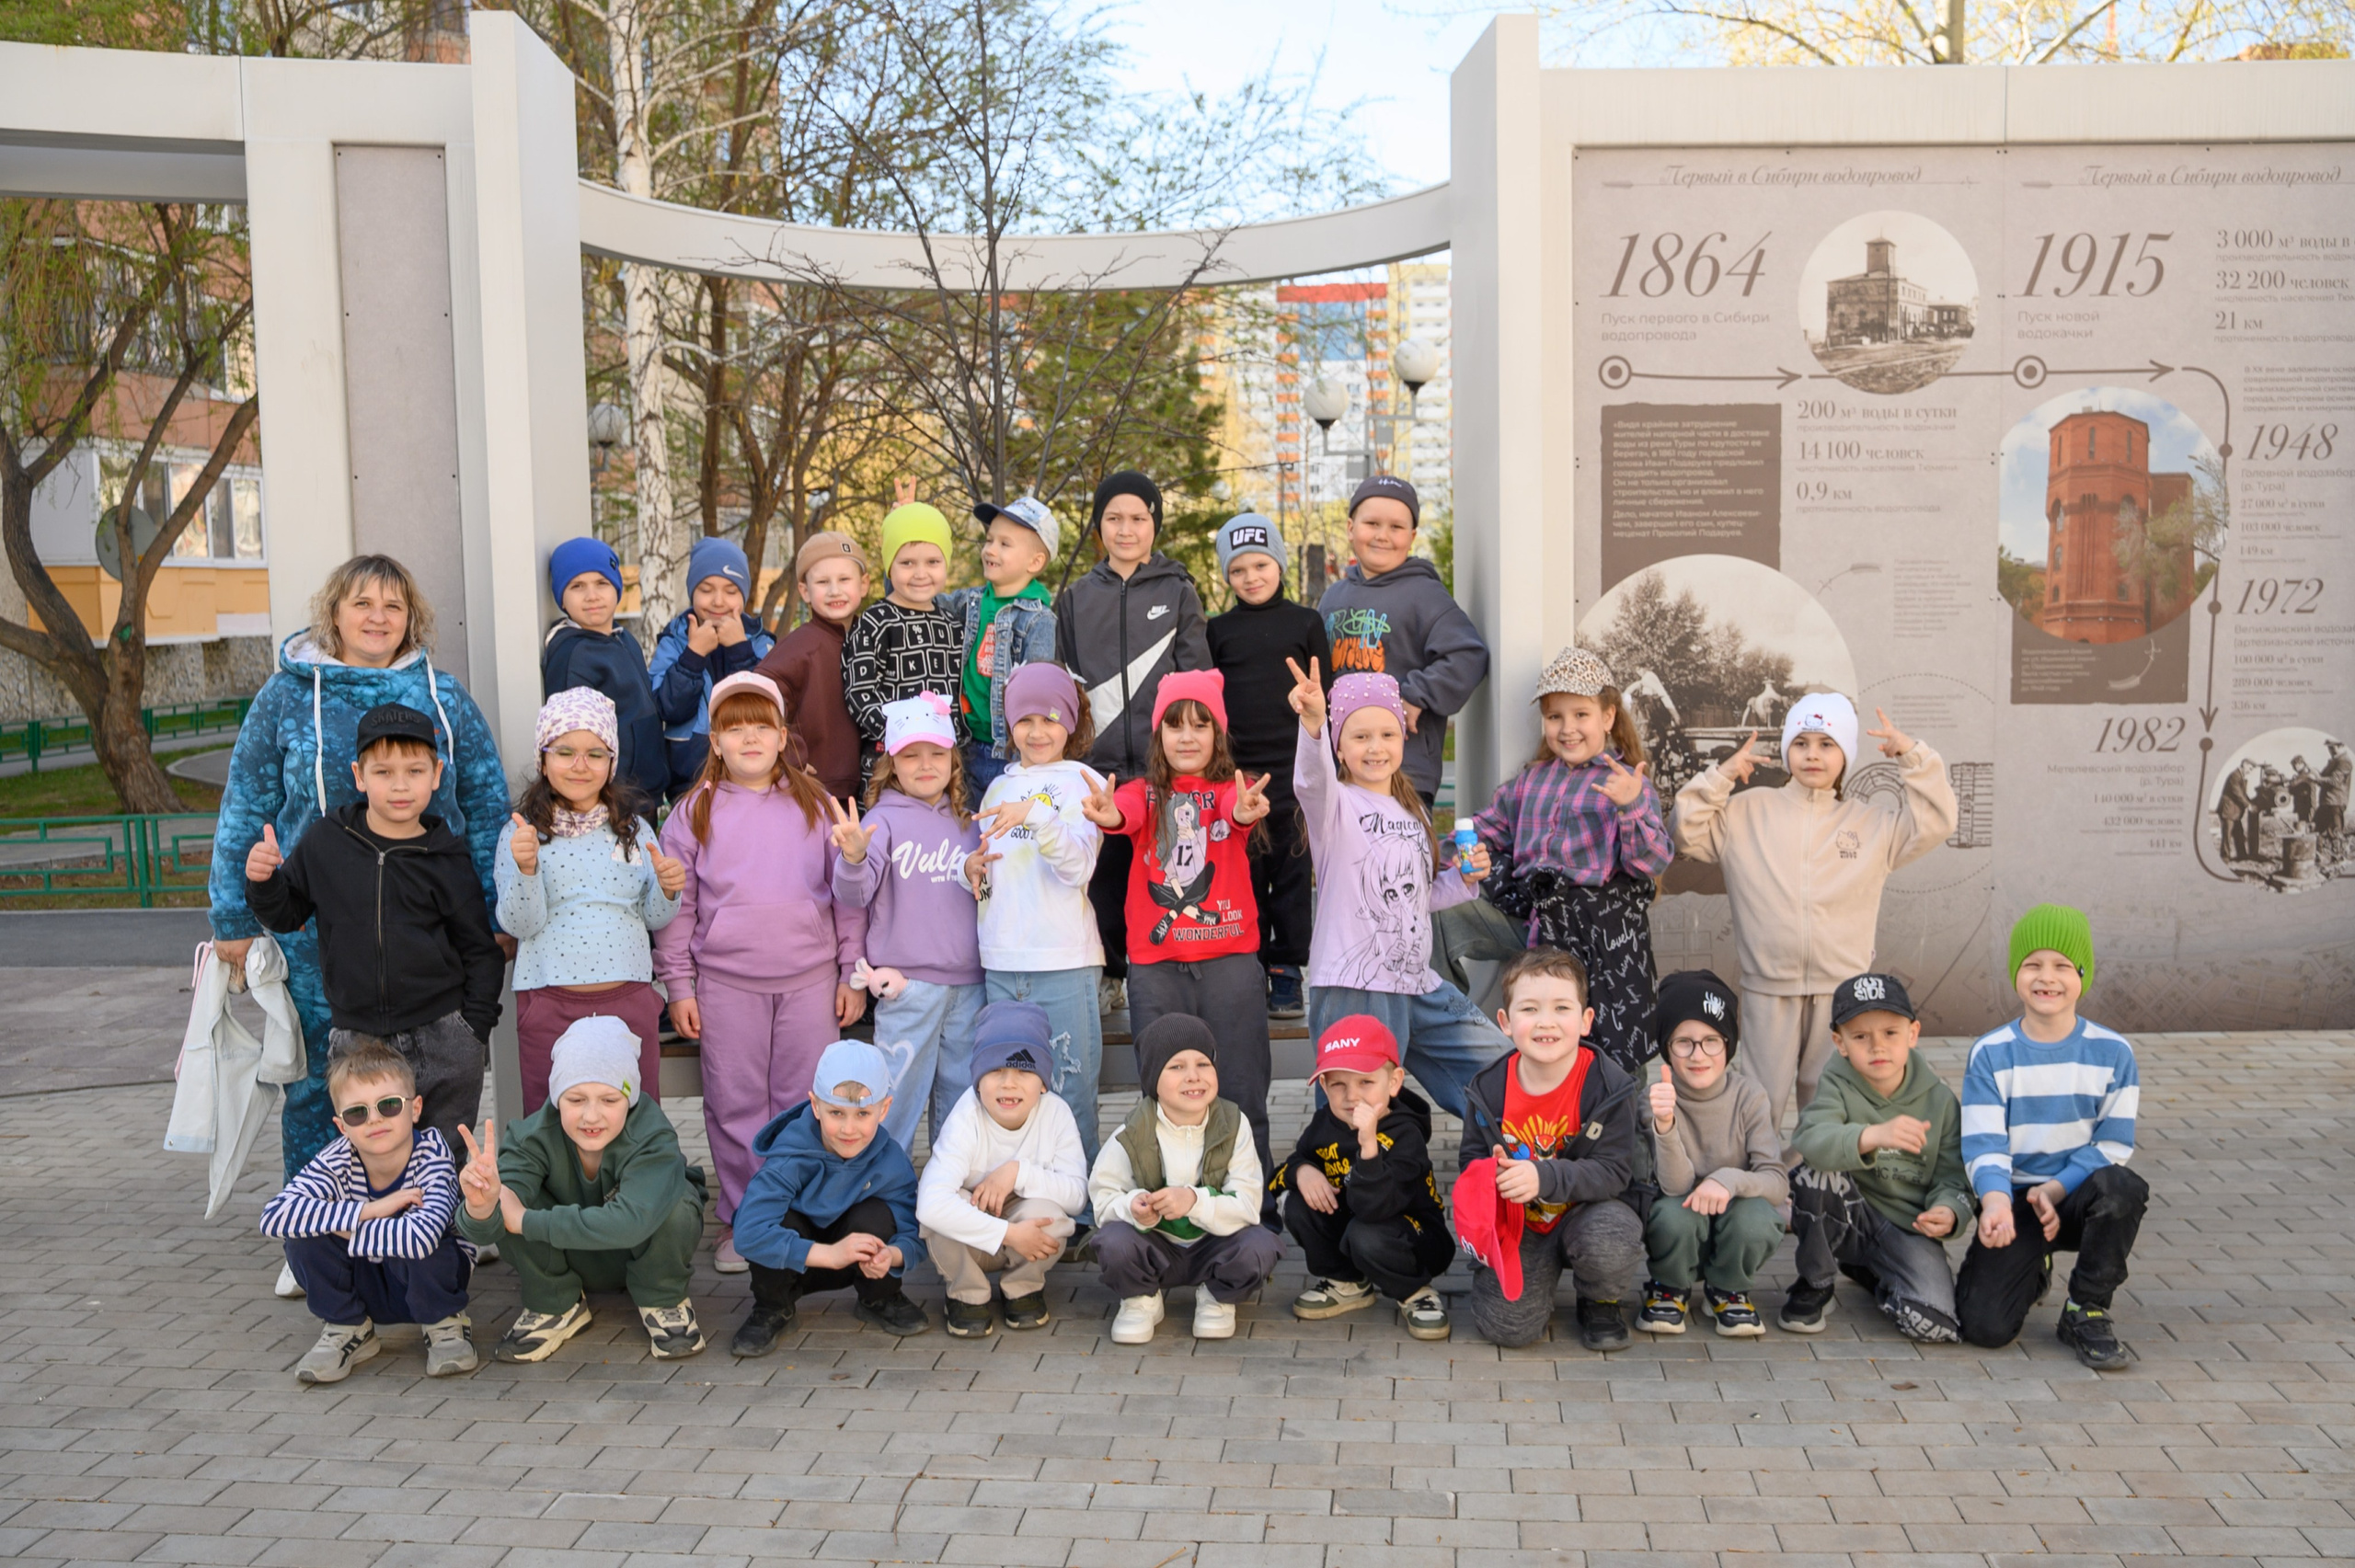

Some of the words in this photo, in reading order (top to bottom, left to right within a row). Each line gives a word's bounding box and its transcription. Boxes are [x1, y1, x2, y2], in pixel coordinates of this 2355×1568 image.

[1752, 166, 1818, 187] Сибири
[1822, 166, 1923, 187] водопровод
[2170, 166, 2237, 188] Сибири
[2241, 166, 2341, 187] водопровод
[2216, 229, 2228, 248] 3
[2234, 228, 2273, 248] 000
[2300, 237, 2337, 250] воды
[2342, 237, 2349, 248] в
[1599, 230, 1772, 299] 1864
[2013, 230, 2175, 299] 1915
[2216, 270, 2240, 290] 32
[2247, 269, 2285, 290] 200
[2291, 278, 2349, 289] человек
[1601, 312, 1636, 326] Пуск
[1639, 313, 1698, 326] первого
[1702, 315, 1710, 324] в
[1713, 311, 1770, 325] Сибири
[2017, 311, 2052, 326] Пуск
[2055, 309, 2099, 322] новой
[2215, 311, 2235, 329] 21
[2244, 319, 2262, 329] км
[1601, 331, 1697, 342] водопровода
[2017, 327, 2094, 339] водокачки
[1798, 399, 1836, 419] 200
[1862, 408, 1899, 421] воды
[1903, 408, 1912, 418] в
[1915, 407, 1958, 423] сутки
[1799, 441, 1821, 460] 14
[1828, 440, 1861, 460] 100
[1866, 448, 1924, 460] человек
[2241, 423, 2338, 461] 1948
[1796, 480, 1828, 501] 0,9
[1832, 489, 1853, 500] км
[1233, 528, 1266, 546] UFC
[2232, 578, 2324, 615] 1972
[909, 660, 916, 671] K
[2089, 715, 2186, 754] 1982
[1222, 910, 1244, 922] LOOK
[1172, 923, 1244, 942] WONDERFUL
[1603, 918, 1638, 952] Lovely
[1325, 1037, 1361, 1053] SANY
[1005, 1059, 1036, 1070] adidas
